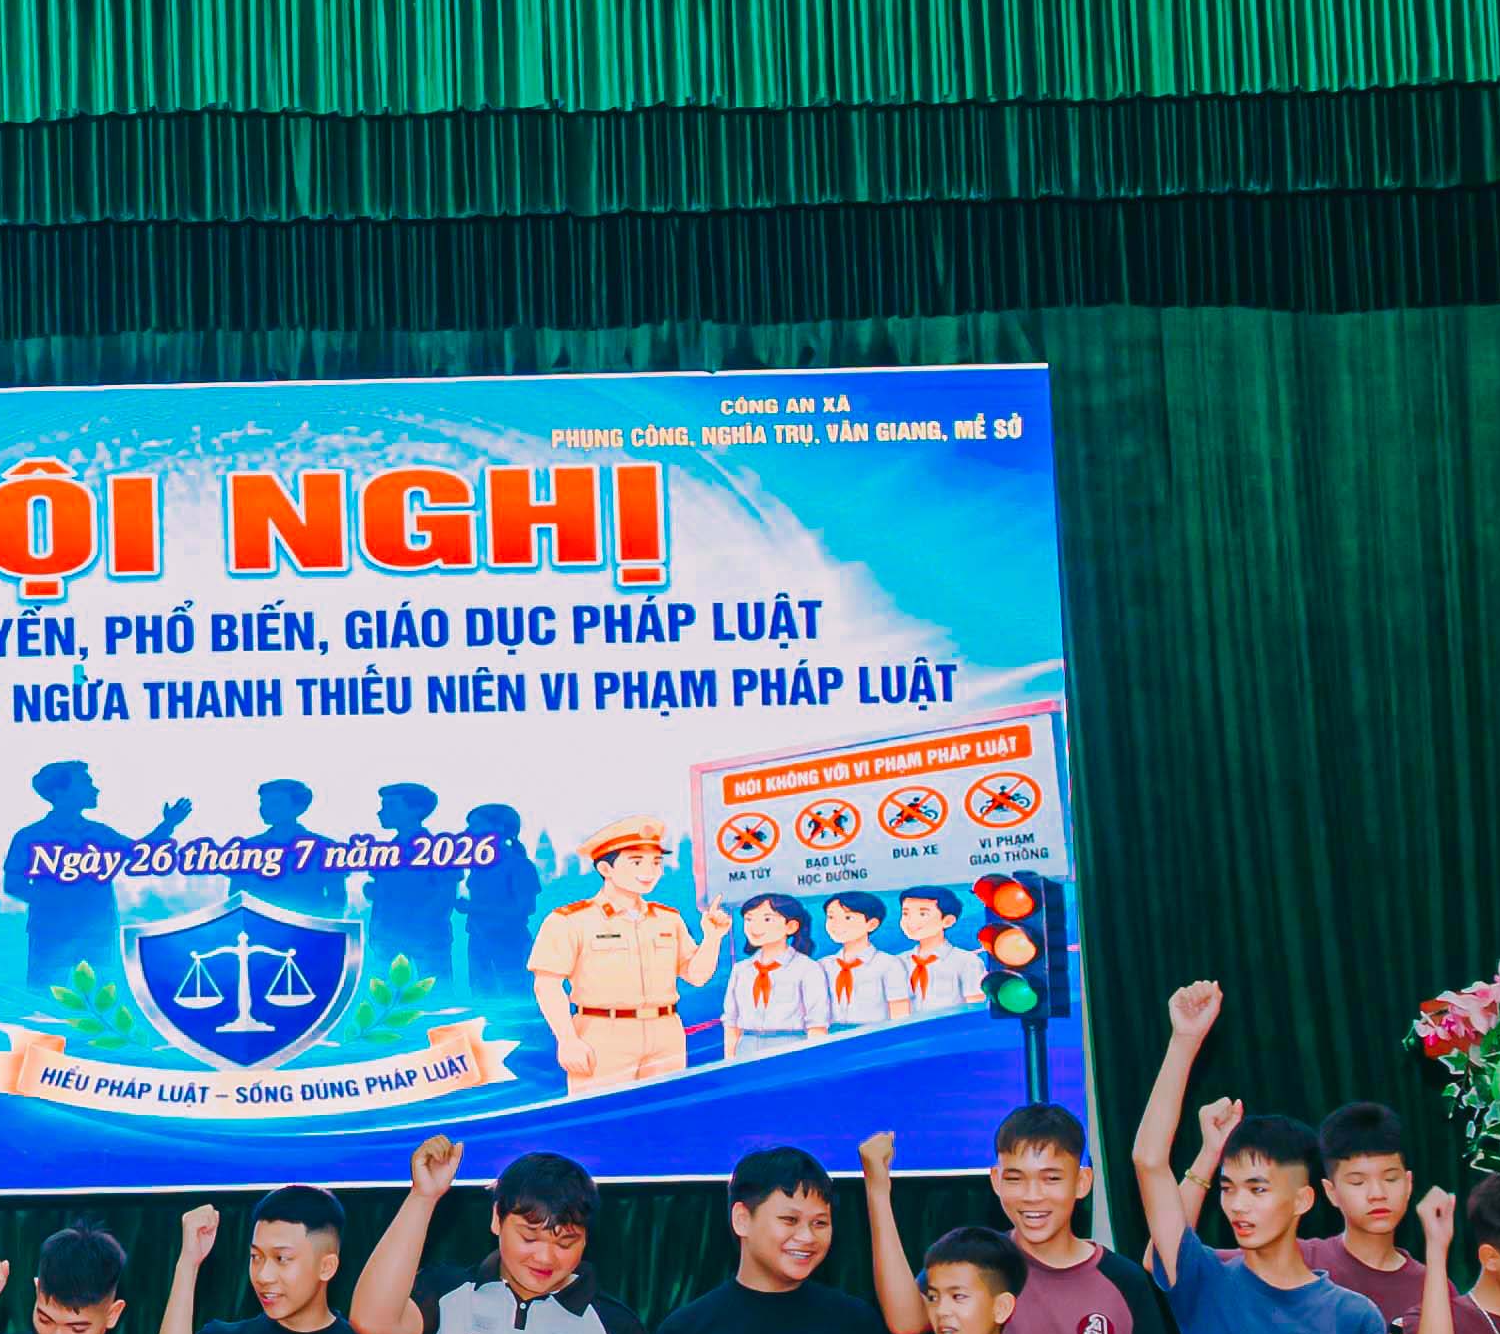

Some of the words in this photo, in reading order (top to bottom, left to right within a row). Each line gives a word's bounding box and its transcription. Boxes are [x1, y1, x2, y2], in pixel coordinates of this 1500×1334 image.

[721, 396, 778, 416] CÔNG
[786, 397, 814, 414] AN
[552, 427, 623, 451] PHỤNG
[702, 424, 766, 444] NGHĨA
[827, 421, 868, 443] VĂN
[875, 420, 947, 442] GIANG,
[228, 462, 666, 589] NGHỊ
[104, 600, 195, 655] PHỔ
[211, 598, 329, 656] BIẾN,
[344, 601, 450, 650] GIÁO
[465, 605, 556, 656] DỤC
[572, 595, 697, 644] PHÁP
[712, 592, 823, 650] LUẬT
[143, 679, 282, 720] THANH
[296, 662, 412, 715] THIẾU
[428, 667, 527, 713] NIÊN
[541, 671, 579, 711] VI
[595, 669, 717, 716] PHẠM
[732, 661, 844, 707] PHÁP
[858, 657, 957, 711] LUẬT
[735, 778, 761, 796] NÓI
[766, 768, 819, 792] KHÔNG
[854, 761, 869, 778] VI
[874, 752, 922, 775] PHẠM
[926, 744, 971, 766] PHÁP
[976, 735, 1017, 758] LUẬT
[29, 844, 121, 882] Ngày
[130, 842, 173, 873] 26
[183, 839, 284, 875] tháng
[296, 840, 316, 867] 7
[325, 839, 400, 867] năm
[411, 835, 496, 866] 2026
[923, 844, 939, 856] XE
[970, 853, 1000, 866] GIAO
[1005, 848, 1048, 861] THÔNG
[979, 838, 992, 849] VI
[728, 871, 746, 882] MA
[95, 1075, 152, 1100] PHÁP
[157, 1079, 211, 1108] LUẬT
[235, 1076, 293, 1104] SỐNG
[300, 1072, 359, 1101] ĐÚNG
[365, 1066, 419, 1097] PHÁP
[423, 1052, 471, 1085] LUẬT
